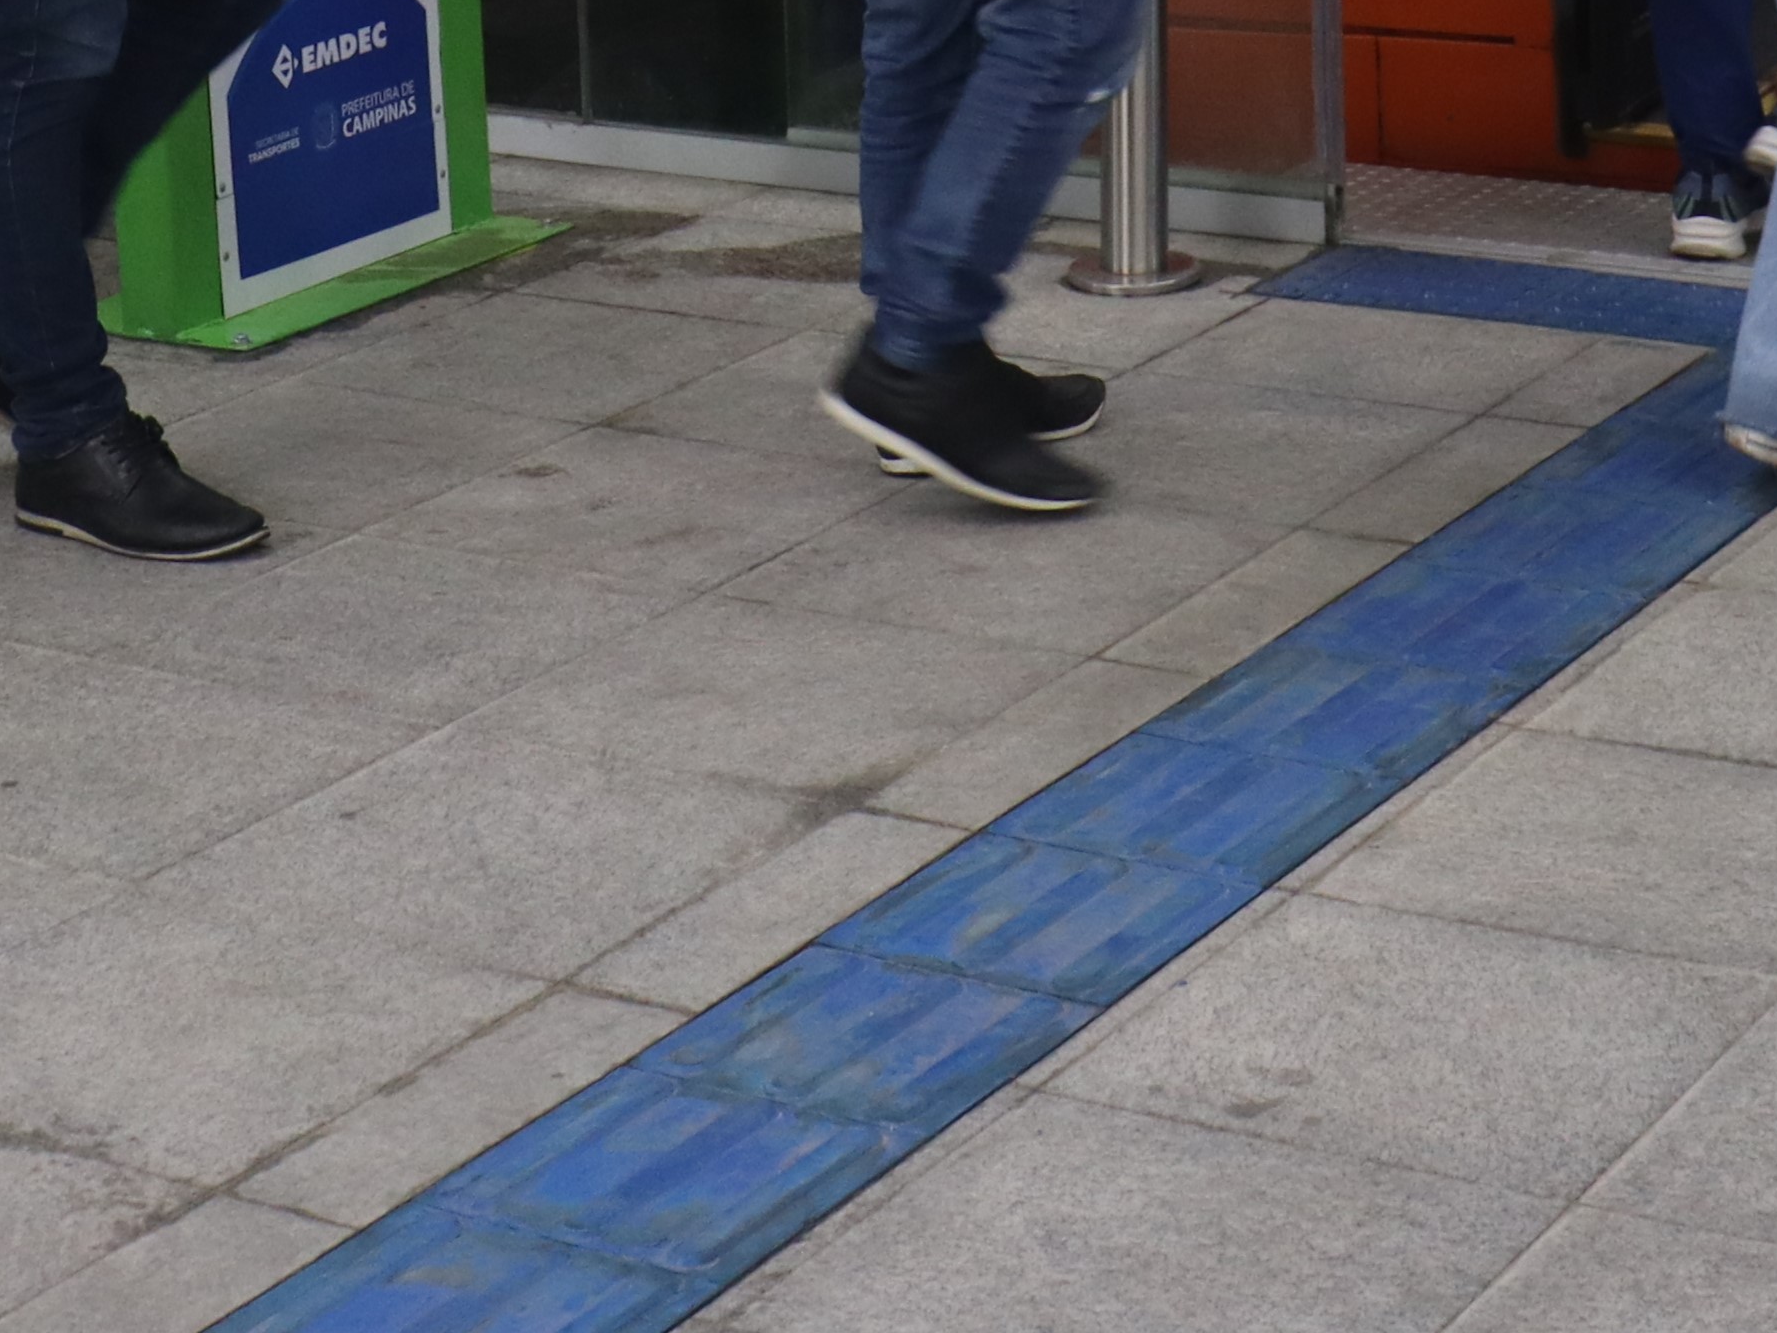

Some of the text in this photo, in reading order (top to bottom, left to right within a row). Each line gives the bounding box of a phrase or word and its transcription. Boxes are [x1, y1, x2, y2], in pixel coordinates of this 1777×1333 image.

[301, 21, 387, 73] EMDEC
[341, 80, 415, 117] PREFEITURA DE
[342, 96, 417, 138] CAMPINAS
[248, 137, 301, 164] TRANSPORTES
